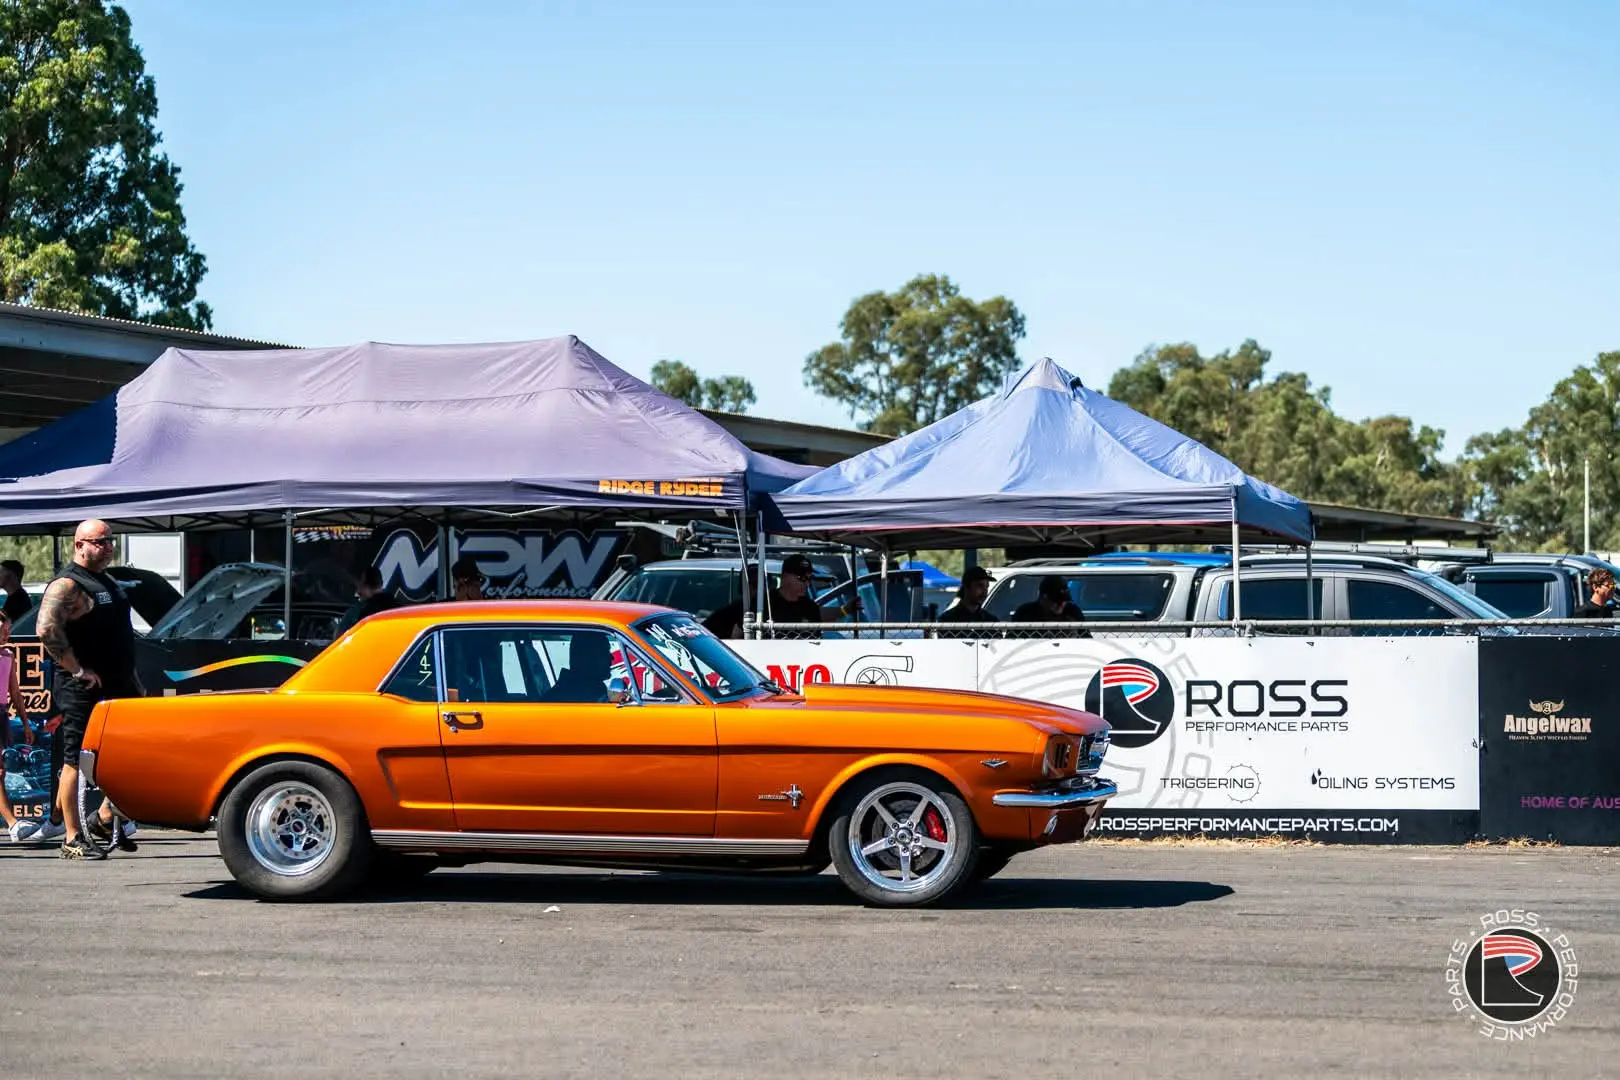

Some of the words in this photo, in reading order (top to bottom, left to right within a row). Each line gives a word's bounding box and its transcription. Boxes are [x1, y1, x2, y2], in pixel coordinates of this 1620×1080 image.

[598, 479, 655, 494] RIDGE
[659, 481, 723, 496] RYDER
[1186, 680, 1348, 717] ROSS
[1186, 721, 1293, 732] PERFORMANCE
[1301, 721, 1349, 732] PARTS
[1504, 714, 1591, 735] Angelwax
[1160, 777, 1255, 789] TRIGGERING
[1318, 777, 1369, 789] OILING
[1375, 777, 1456, 790] SYSTEMS
[1521, 796, 1565, 808] HOME
[1568, 797, 1589, 808] OF
